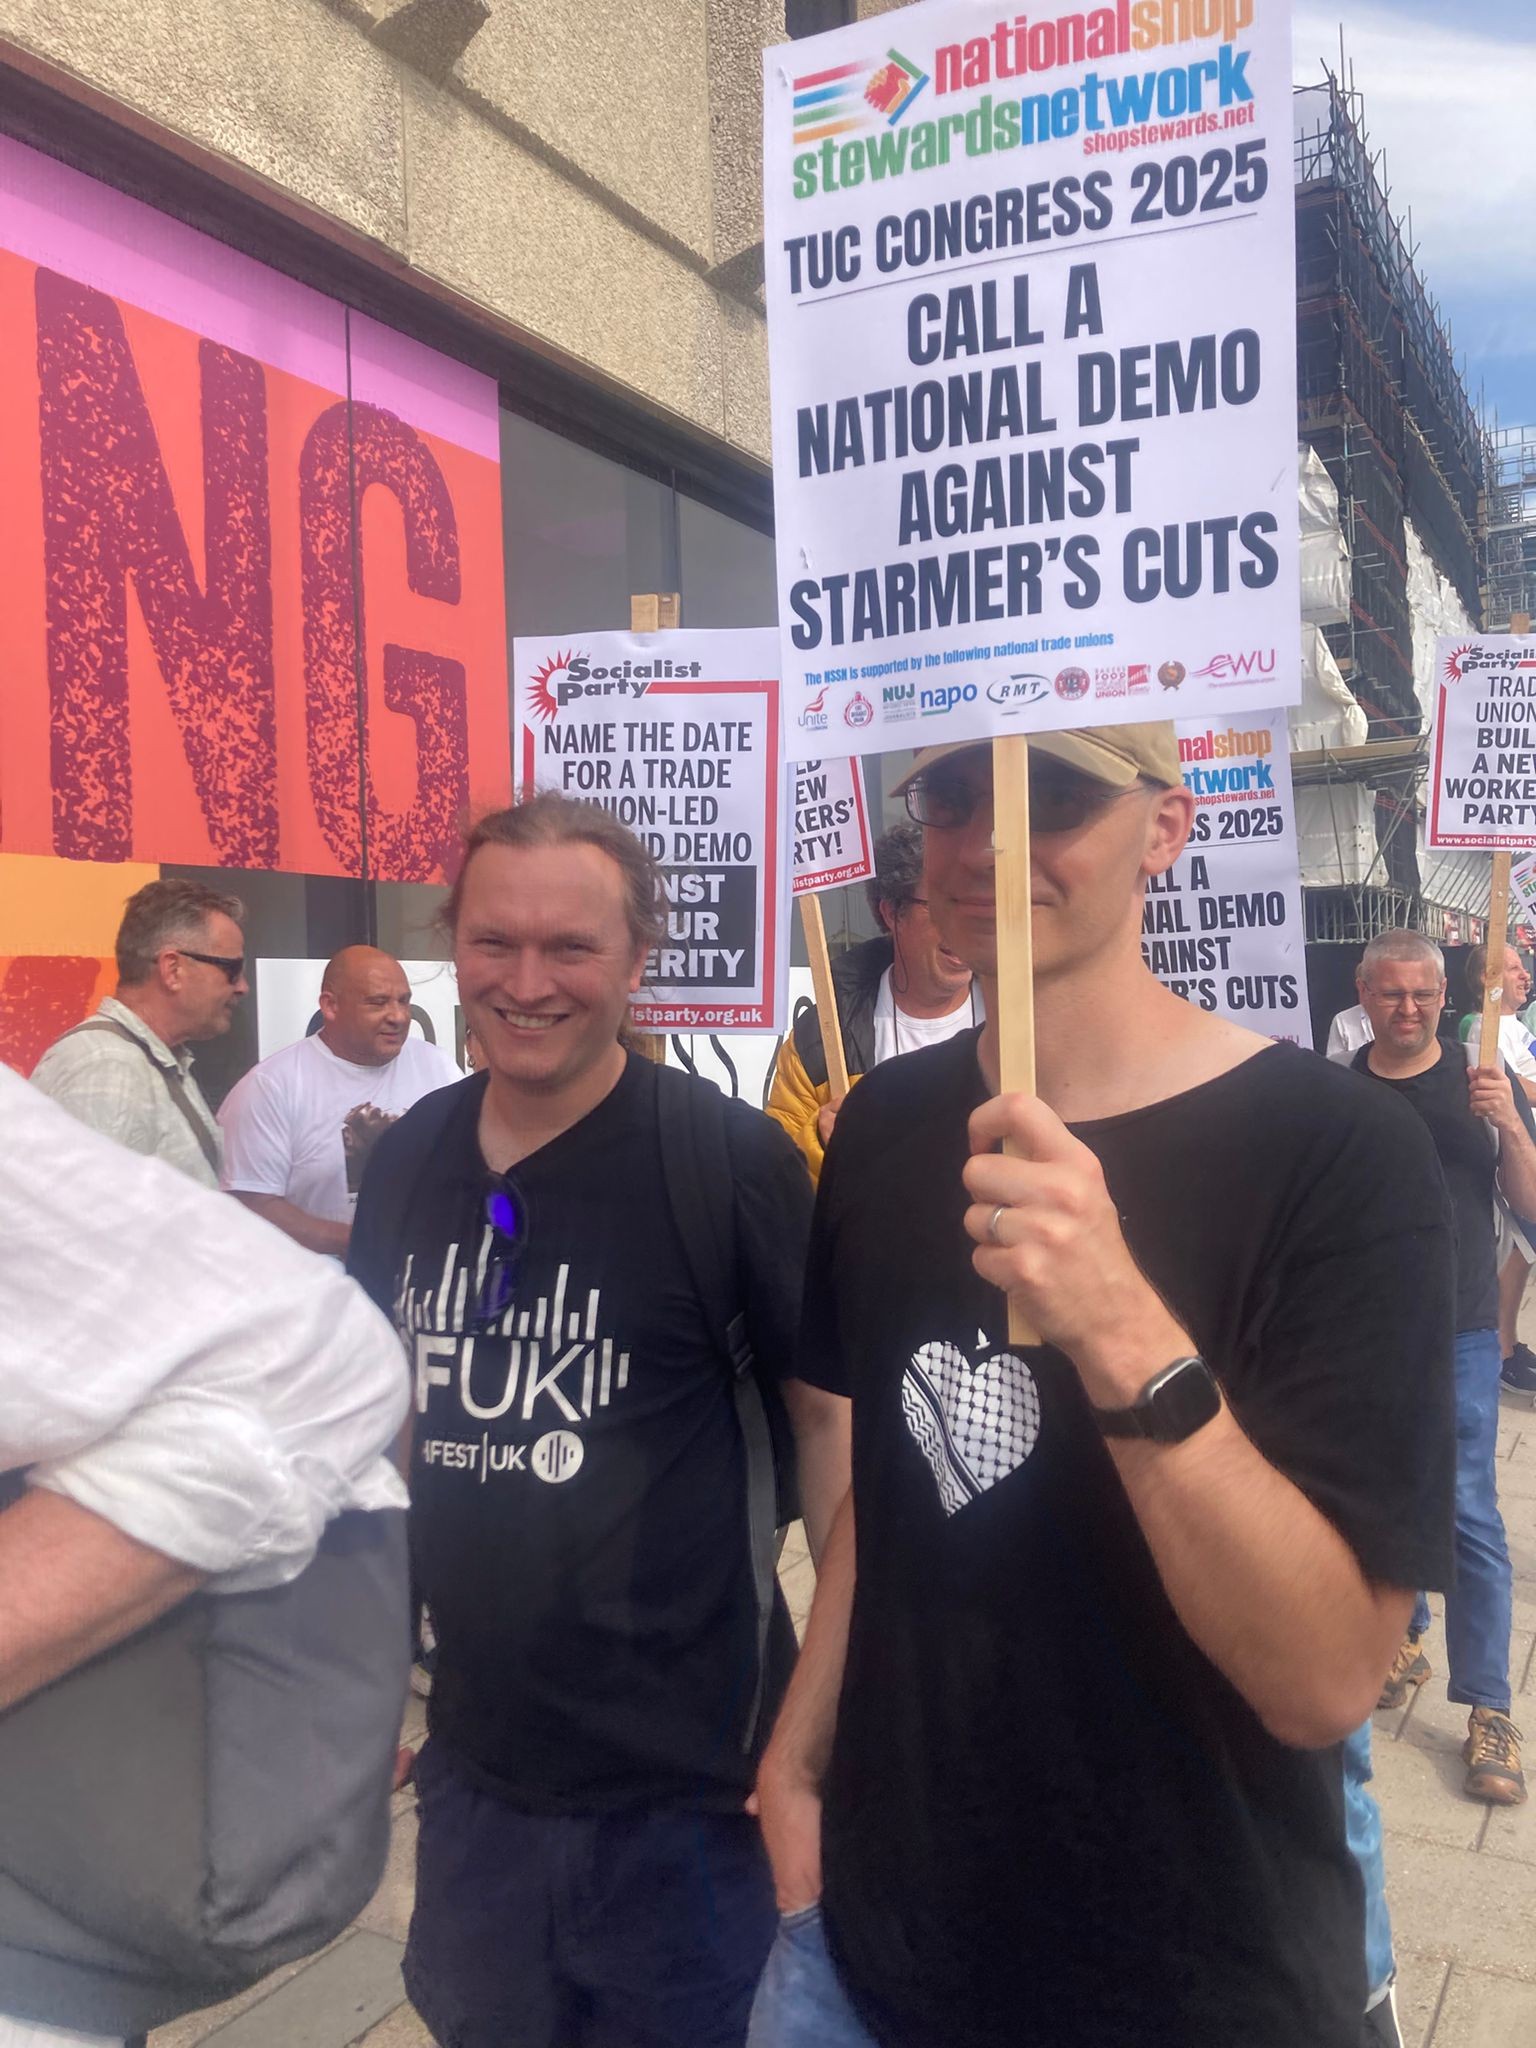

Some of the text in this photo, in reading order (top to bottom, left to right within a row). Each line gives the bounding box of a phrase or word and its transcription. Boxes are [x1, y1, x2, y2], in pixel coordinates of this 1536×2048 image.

[793, 44, 1254, 199] stewardsnetwork
[1083, 103, 1255, 156] shopstewards.net
[783, 138, 1269, 294] TUC CONGRESS 2025
[906, 261, 1104, 366] CALL A
[796, 327, 1262, 478] NATIONAL DEMO
[898, 437, 1140, 546] AGAINST
[789, 511, 1279, 650] STARMER’S CUTS
[567, 658, 702, 682] Socialist
[805, 632, 1114, 686] The NSSN is supported by the following national trade unions
[1469, 648, 1536, 661] Sociali
[882, 683, 916, 703] NUJ
[920, 684, 977, 711] napo
[1000, 682, 1040, 698] RMT
[544, 722, 752, 754] NAME THE DATE
[1476, 728, 1536, 749] BUIL
[563, 759, 732, 790] FOR A TRADE
[1472, 753, 1536, 774] A NE
[1195, 788, 1276, 807] shopstewards.net
[1218, 806, 1284, 840] 2025
[674, 832, 753, 862] DEMO
[1190, 855, 1211, 891] A
[1198, 891, 1286, 931] DEMO
[1226, 974, 1299, 1011] CUTS
